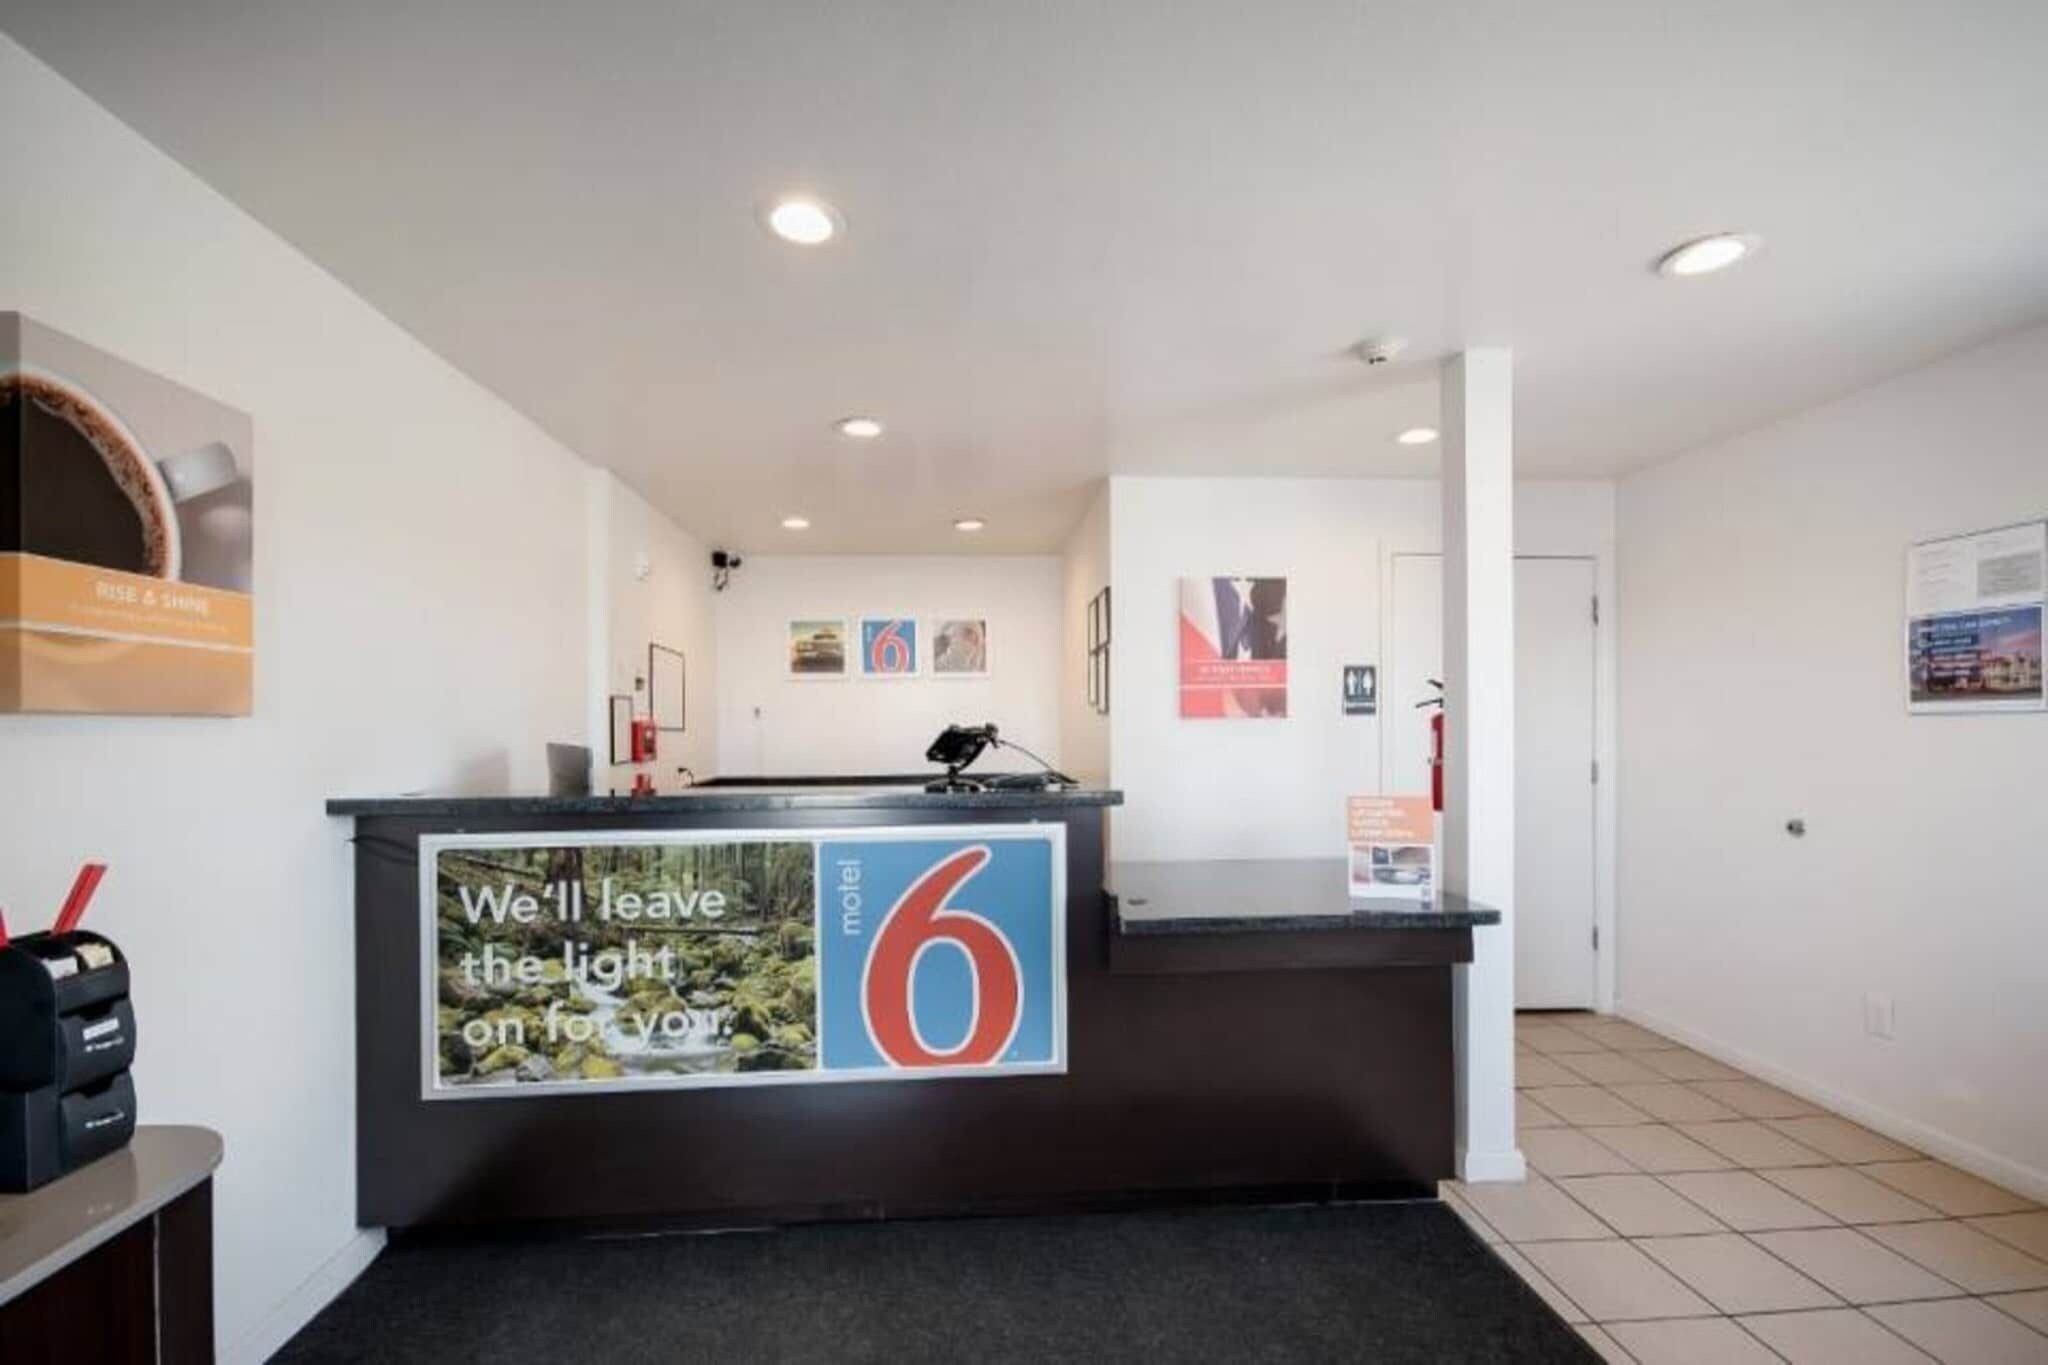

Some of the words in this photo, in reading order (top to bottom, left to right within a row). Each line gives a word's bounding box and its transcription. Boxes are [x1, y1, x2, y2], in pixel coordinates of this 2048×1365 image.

[871, 619, 910, 673] 6
[460, 880, 581, 924] We'll
[602, 878, 727, 921] leave
[837, 859, 862, 936] motel
[460, 943, 544, 986] the
[565, 938, 677, 992] light
[860, 844, 1025, 1070] 6
[462, 1017, 525, 1048] on
[547, 1001, 609, 1043] for
